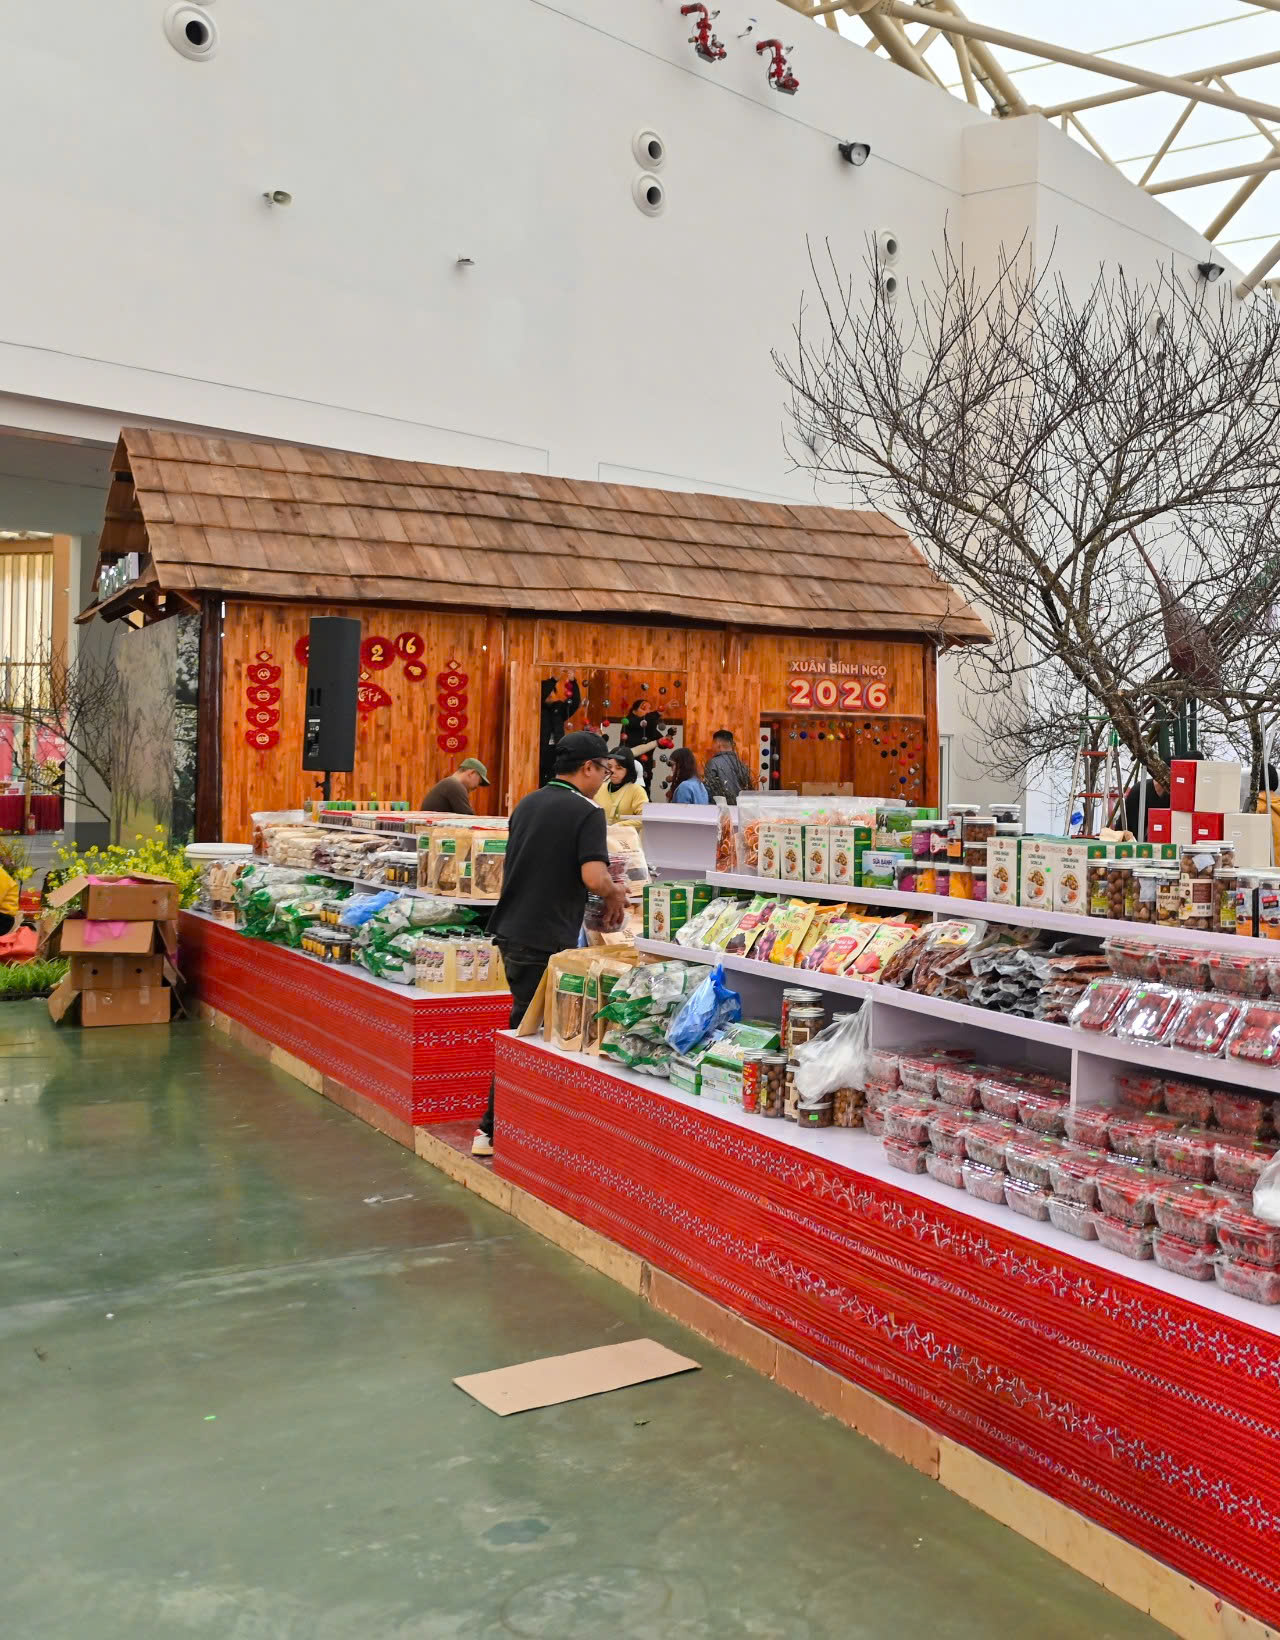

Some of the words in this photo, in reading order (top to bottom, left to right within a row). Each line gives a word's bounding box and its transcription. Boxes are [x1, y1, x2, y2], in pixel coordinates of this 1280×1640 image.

[791, 659, 826, 673] XUÂN
[829, 660, 859, 675] BÍNH
[789, 679, 888, 709] 2026
